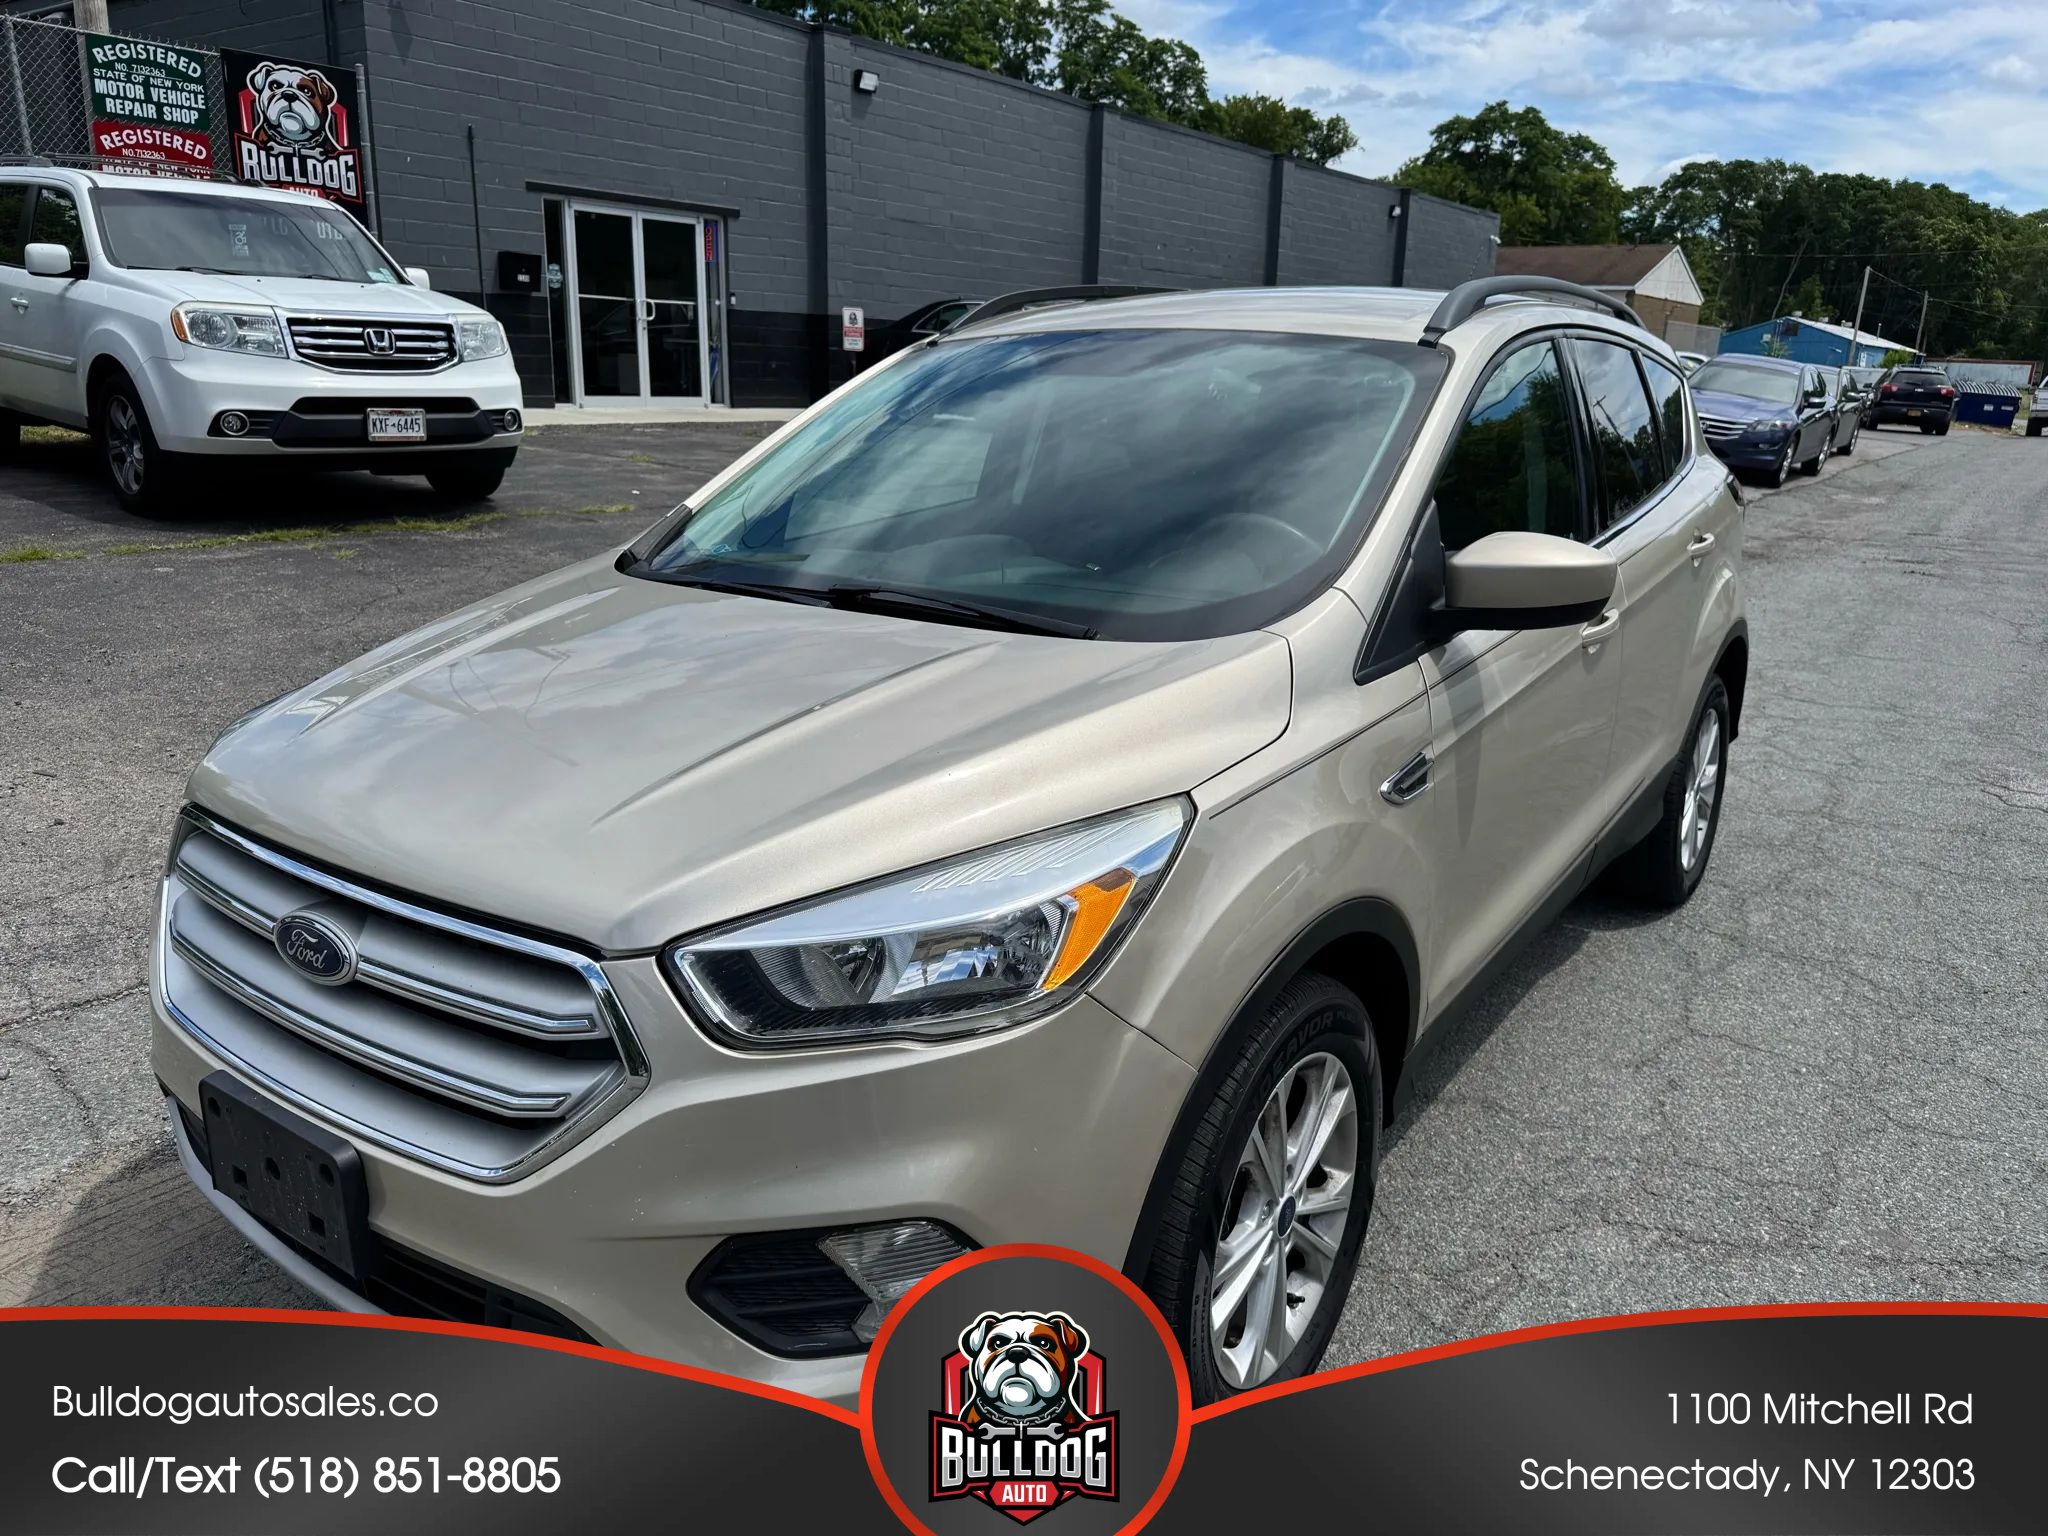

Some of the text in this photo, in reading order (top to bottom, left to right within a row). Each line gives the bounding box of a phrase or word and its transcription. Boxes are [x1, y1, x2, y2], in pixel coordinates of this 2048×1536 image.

[91, 43, 202, 78] REGISTERED
[114, 62, 166, 77] NO. 7132363
[93, 68, 205, 93] STATE OF NEW YORK
[94, 78, 206, 109] MOTOR VEHICLE
[105, 97, 199, 125] REPAIR SHOP
[100, 129, 207, 160] REGISTERED
[240, 140, 357, 197] BULLDOG
[397, 417, 421, 433] 6445
[286, 929, 328, 969] Ford
